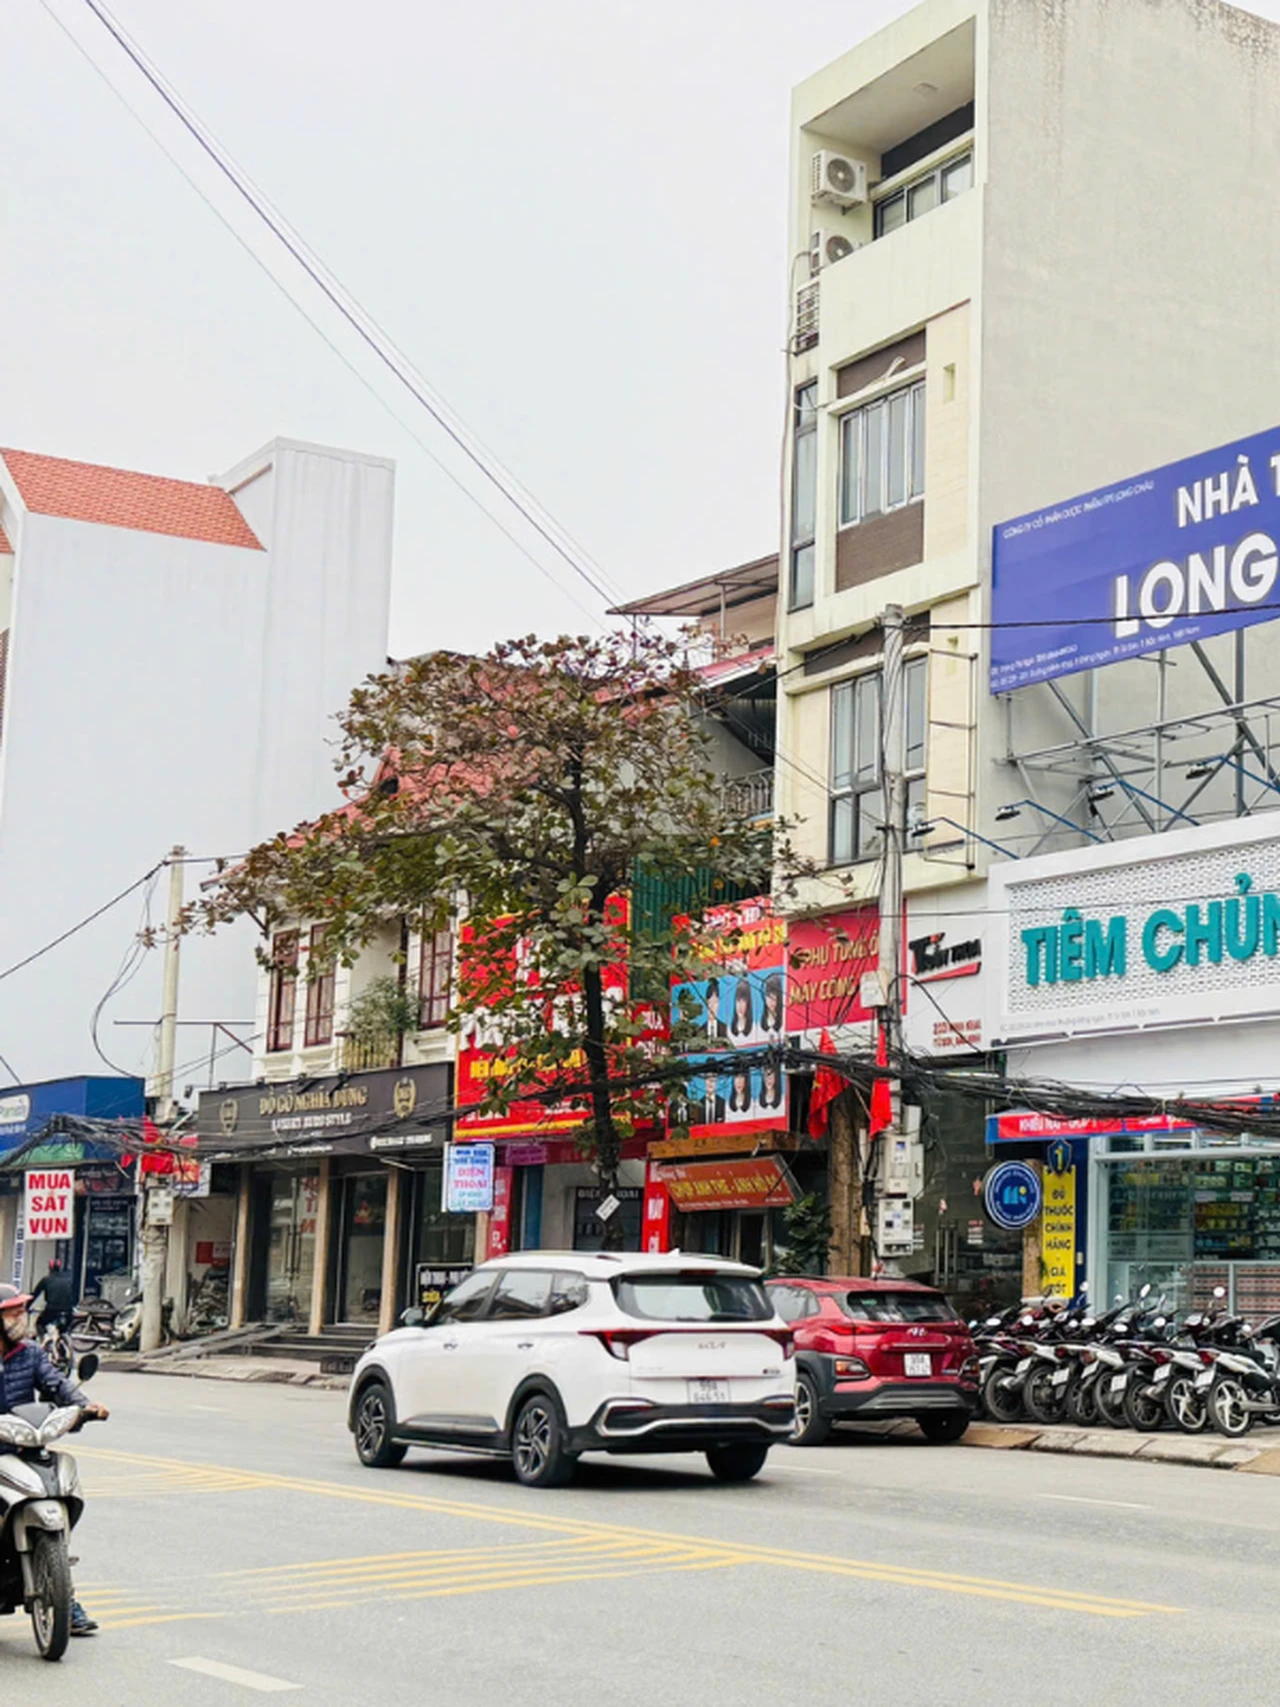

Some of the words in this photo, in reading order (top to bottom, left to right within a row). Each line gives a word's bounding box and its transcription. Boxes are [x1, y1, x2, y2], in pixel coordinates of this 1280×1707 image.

[1177, 454, 1259, 528] NHÀ
[1114, 532, 1280, 638] LONG
[1020, 907, 1128, 986] TIÊM
[28, 1173, 71, 1190] MUA
[1044, 1204, 1073, 1217] THUỐC
[29, 1217, 68, 1238] VỤN
[1045, 1220, 1072, 1233] CHÍNH
